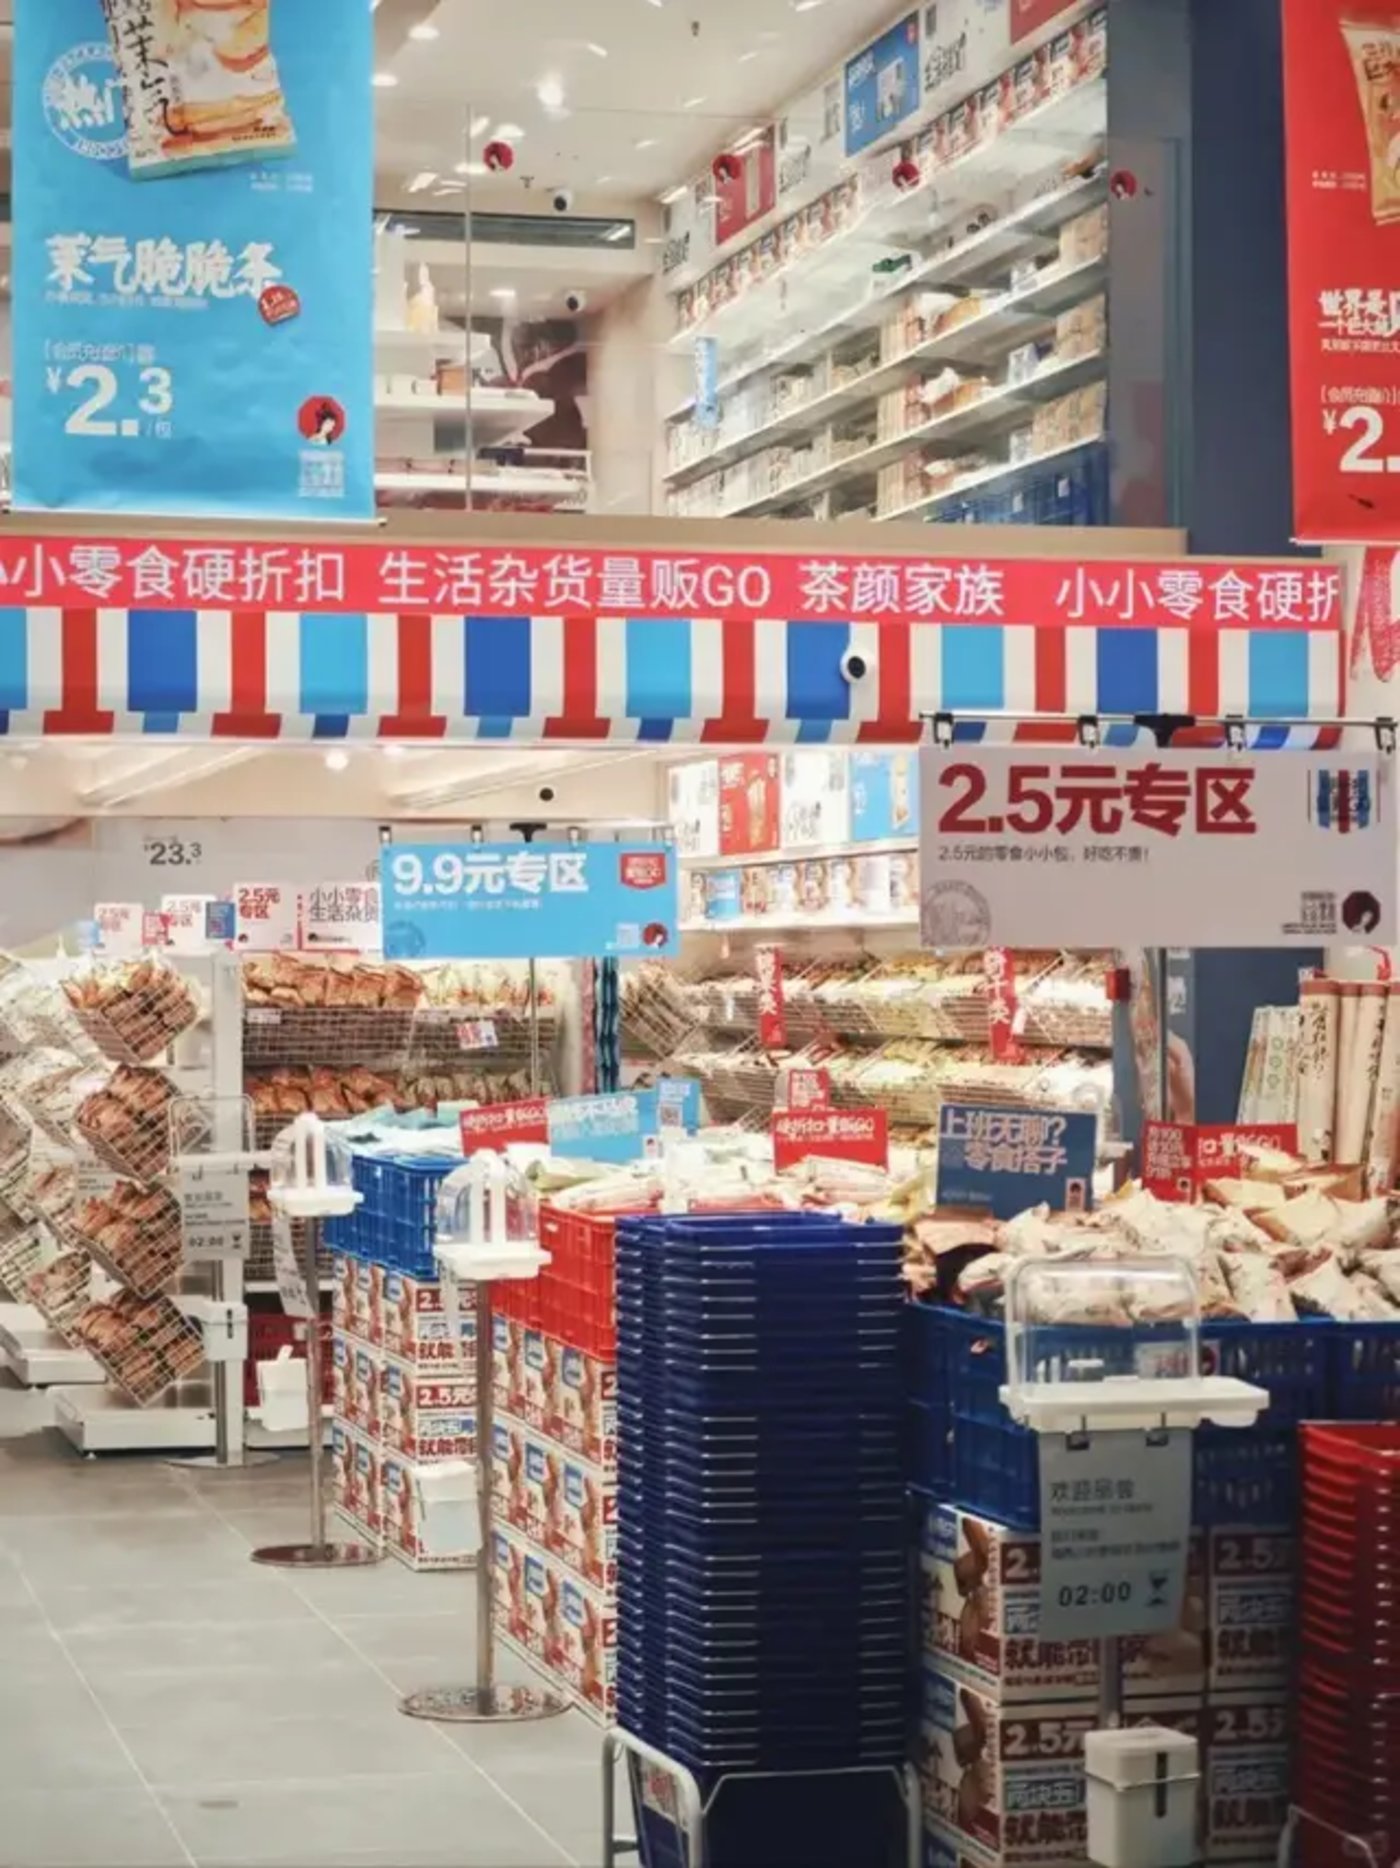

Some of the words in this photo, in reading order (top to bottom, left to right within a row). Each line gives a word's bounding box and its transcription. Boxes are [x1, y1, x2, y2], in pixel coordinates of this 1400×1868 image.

[0, 543, 345, 604] 小零食硬折扣
[378, 551, 773, 613] 生活杂货量贩GO
[800, 562, 1004, 617] 茶颜家族
[938, 762, 1257, 837] 2.5元专区
[391, 851, 589, 896] 9.9元专区
[1058, 1580, 1132, 1607] 02:00
